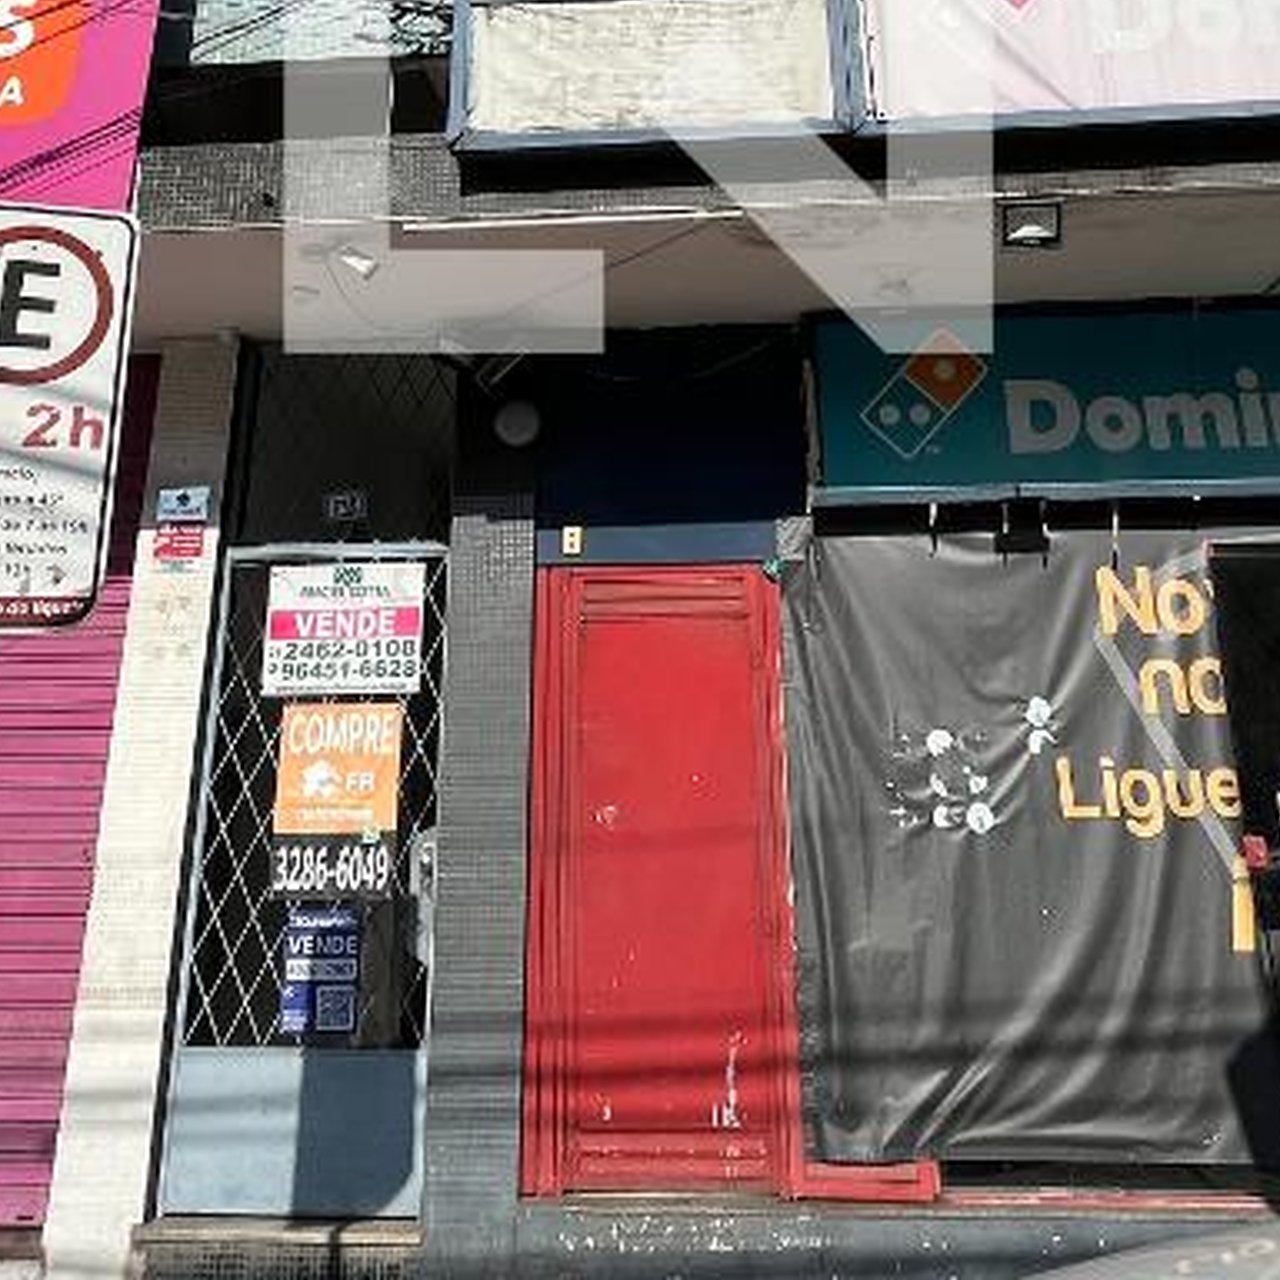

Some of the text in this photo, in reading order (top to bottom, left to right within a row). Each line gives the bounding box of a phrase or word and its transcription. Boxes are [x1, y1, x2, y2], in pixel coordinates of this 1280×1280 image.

[295, 609, 396, 638] VENDE
[288, 713, 396, 755] COMPRE
[1054, 754, 1242, 839] Ligue
[273, 845, 389, 892] 3286-6049
[288, 935, 359, 955] VENDE
